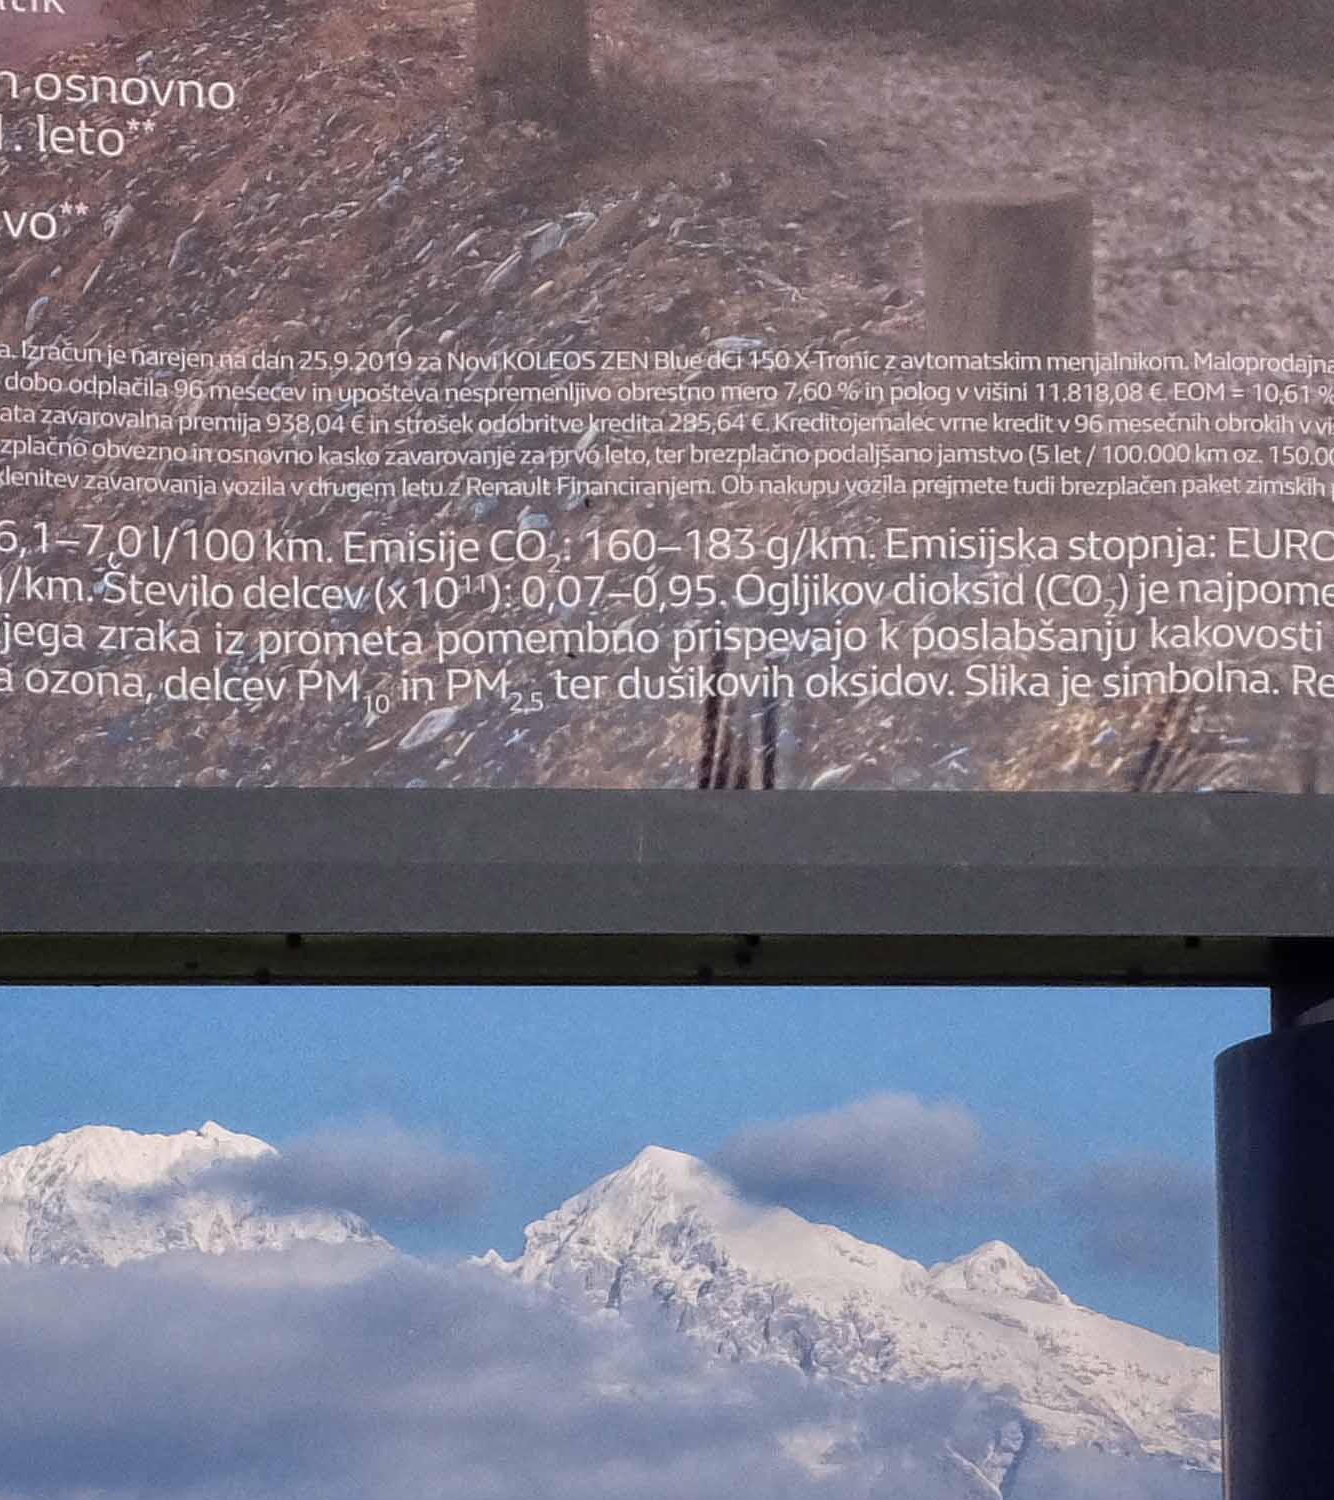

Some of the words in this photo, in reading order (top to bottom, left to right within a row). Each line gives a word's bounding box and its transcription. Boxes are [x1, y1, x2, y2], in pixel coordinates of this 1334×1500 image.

[33, 72, 237, 110] osnovno
[21, 340, 102, 363] Izračun
[107, 344, 127, 368] je
[131, 345, 214, 372] narejen
[219, 353, 247, 369] na
[251, 350, 295, 371] dan
[296, 351, 413, 372] 25.9.2019
[416, 357, 442, 372] za
[447, 352, 498, 372] Novi
[499, 351, 596, 372] KOLEOS
[600, 351, 649, 371] ZEN
[654, 351, 703, 371] Blue
[748, 350, 791, 370] 150
[794, 350, 881, 370] X-Tronic
[884, 354, 898, 369] z
[900, 350, 1042, 371] avtomatskim
[1046, 351, 1189, 375] menjalnikom.
[149, 527, 256, 569] l/100
[265, 531, 334, 564] km.
[344, 531, 481, 570] Emisije
[766, 528, 876, 567] g/km.
[886, 528, 1058, 566] Emisijska
[1068, 527, 1216, 566] stopnja:
[102, 565, 236, 608] Število
[240, 576, 367, 609] delcev
[735, 574, 885, 614] Ogljikov
[894, 573, 1025, 606] dioksid
[1139, 572, 1170, 611] je
[97, 618, 201, 654] zraka
[215, 622, 249, 655] iz
[258, 627, 424, 662] prometa
[437, 621, 660, 661] pomembno
[672, 620, 868, 659] prispevajo
[880, 619, 900, 651] k
[912, 619, 1137, 658] poslabšanju
[1150, 617, 1323, 652] kakovosti
[27, 669, 154, 702] ozona,
[164, 668, 292, 701] delcev
[400, 669, 437, 701] in
[553, 671, 609, 700] ter
[617, 665, 795, 699] dušikovih
[805, 665, 955, 697] oksidov.
[965, 665, 1050, 697] Slika
[1061, 665, 1097, 703] je
[1102, 662, 1280, 697] simbolna.
